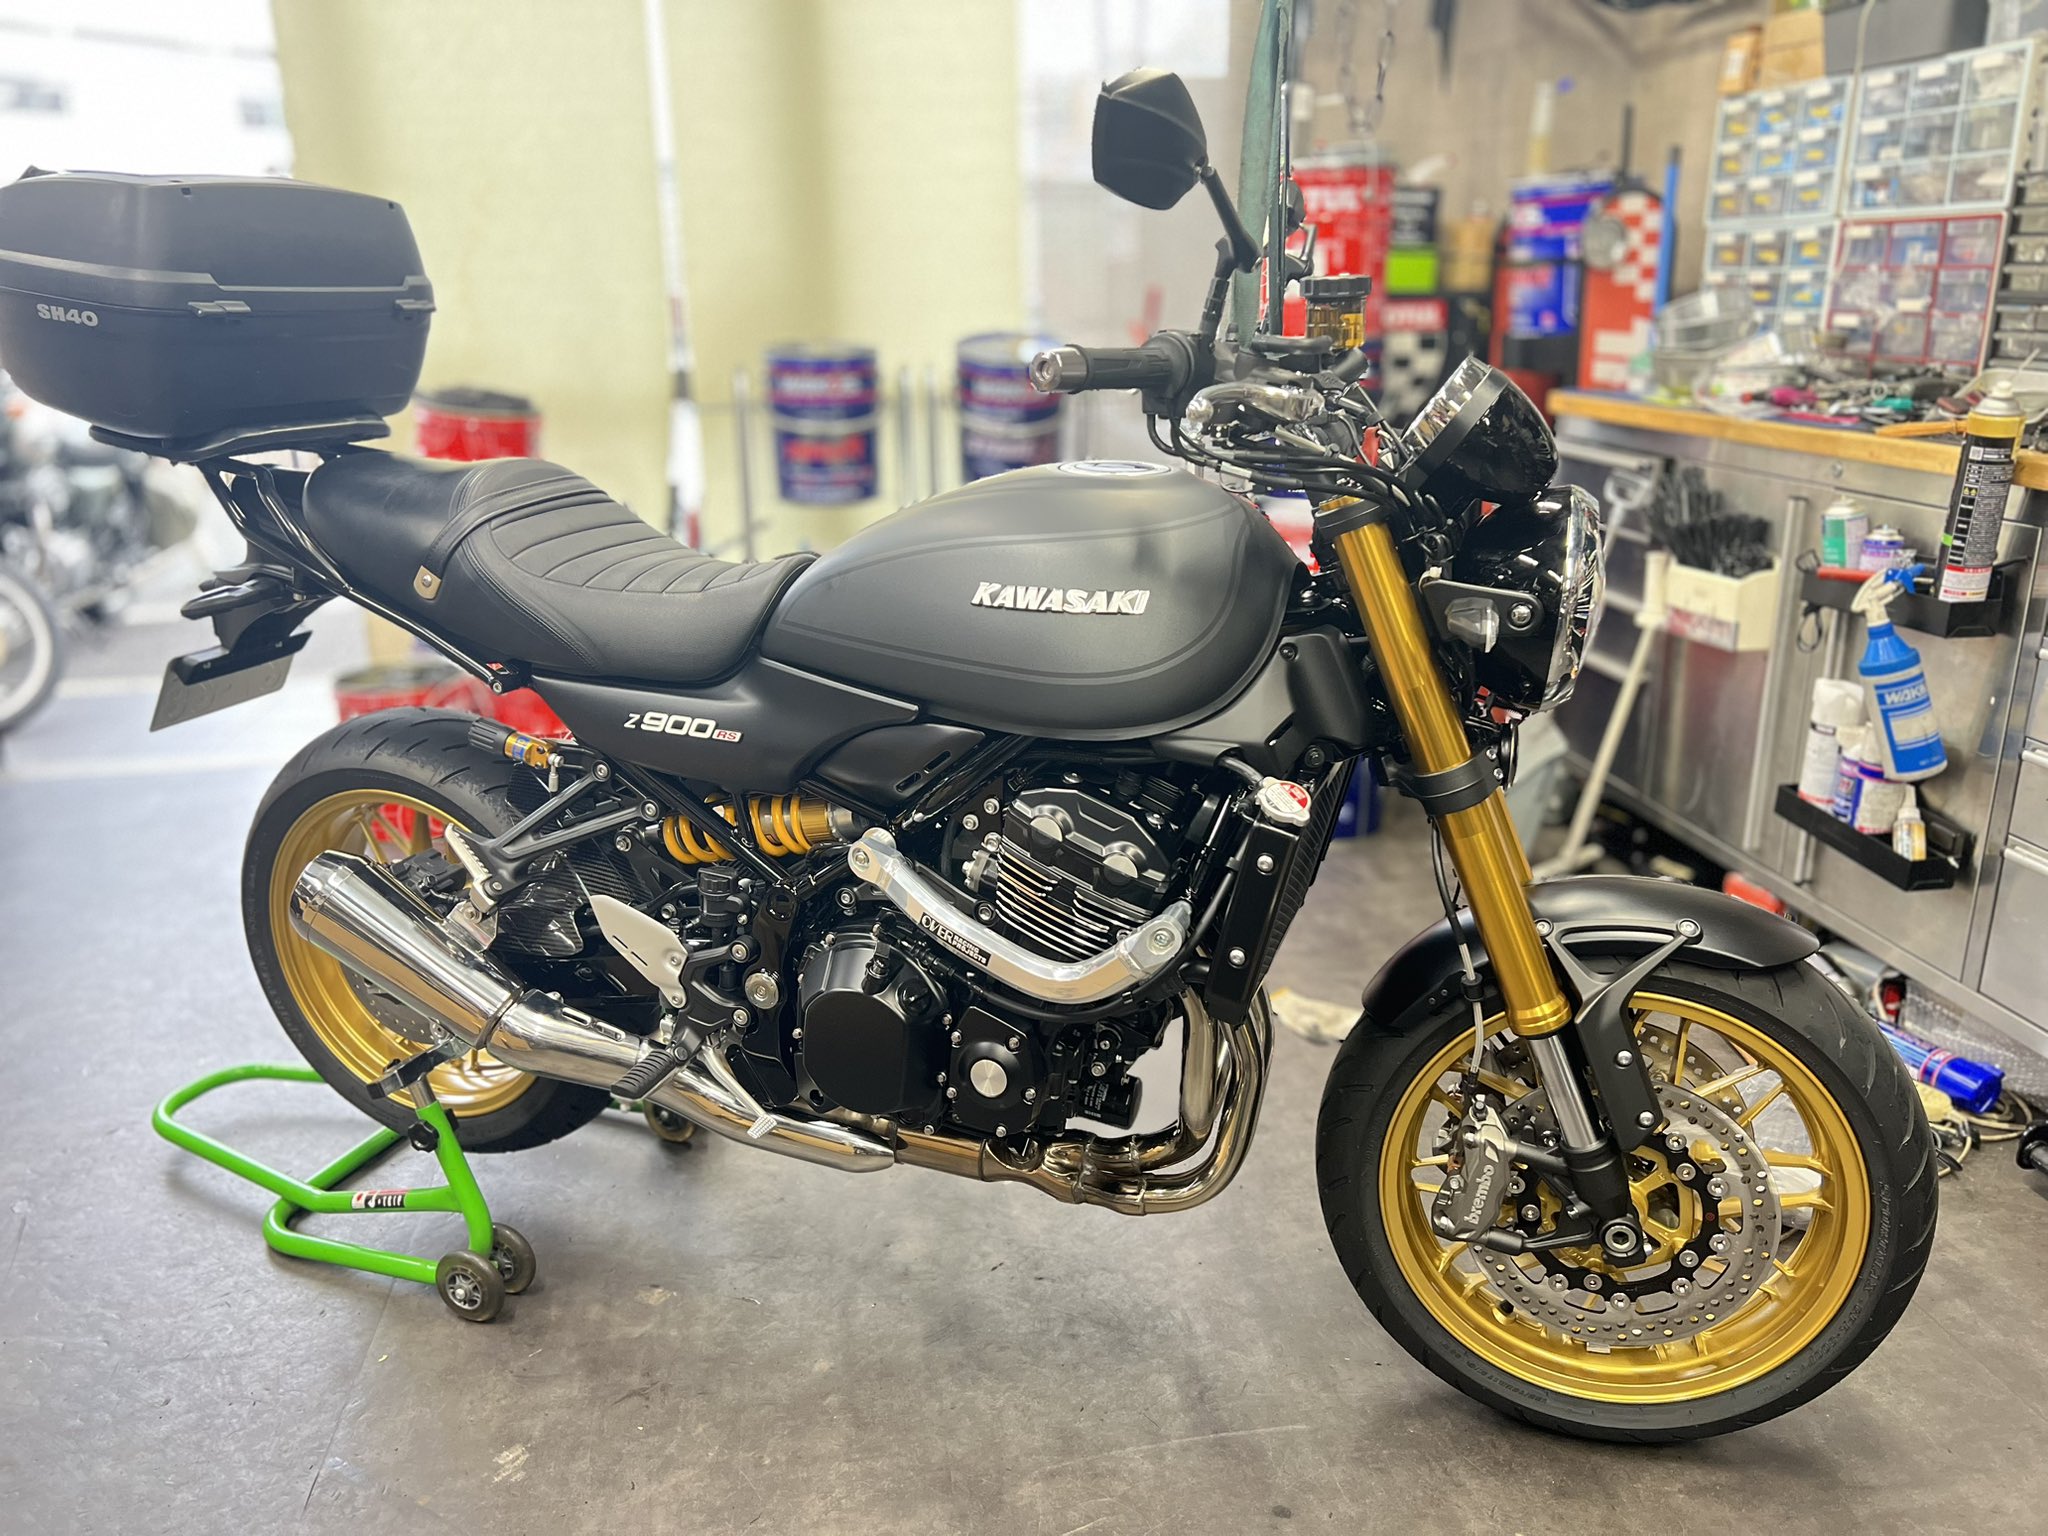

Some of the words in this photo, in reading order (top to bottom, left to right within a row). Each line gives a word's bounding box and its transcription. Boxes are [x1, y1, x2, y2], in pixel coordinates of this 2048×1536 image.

[36, 303, 99, 327] SH40
[970, 581, 1151, 615] KAWASAKI
[921, 914, 954, 945] OVER
[951, 941, 987, 965] PROJECTS
[953, 935, 980, 954] RACING
[1463, 1164, 1495, 1226] brembo
